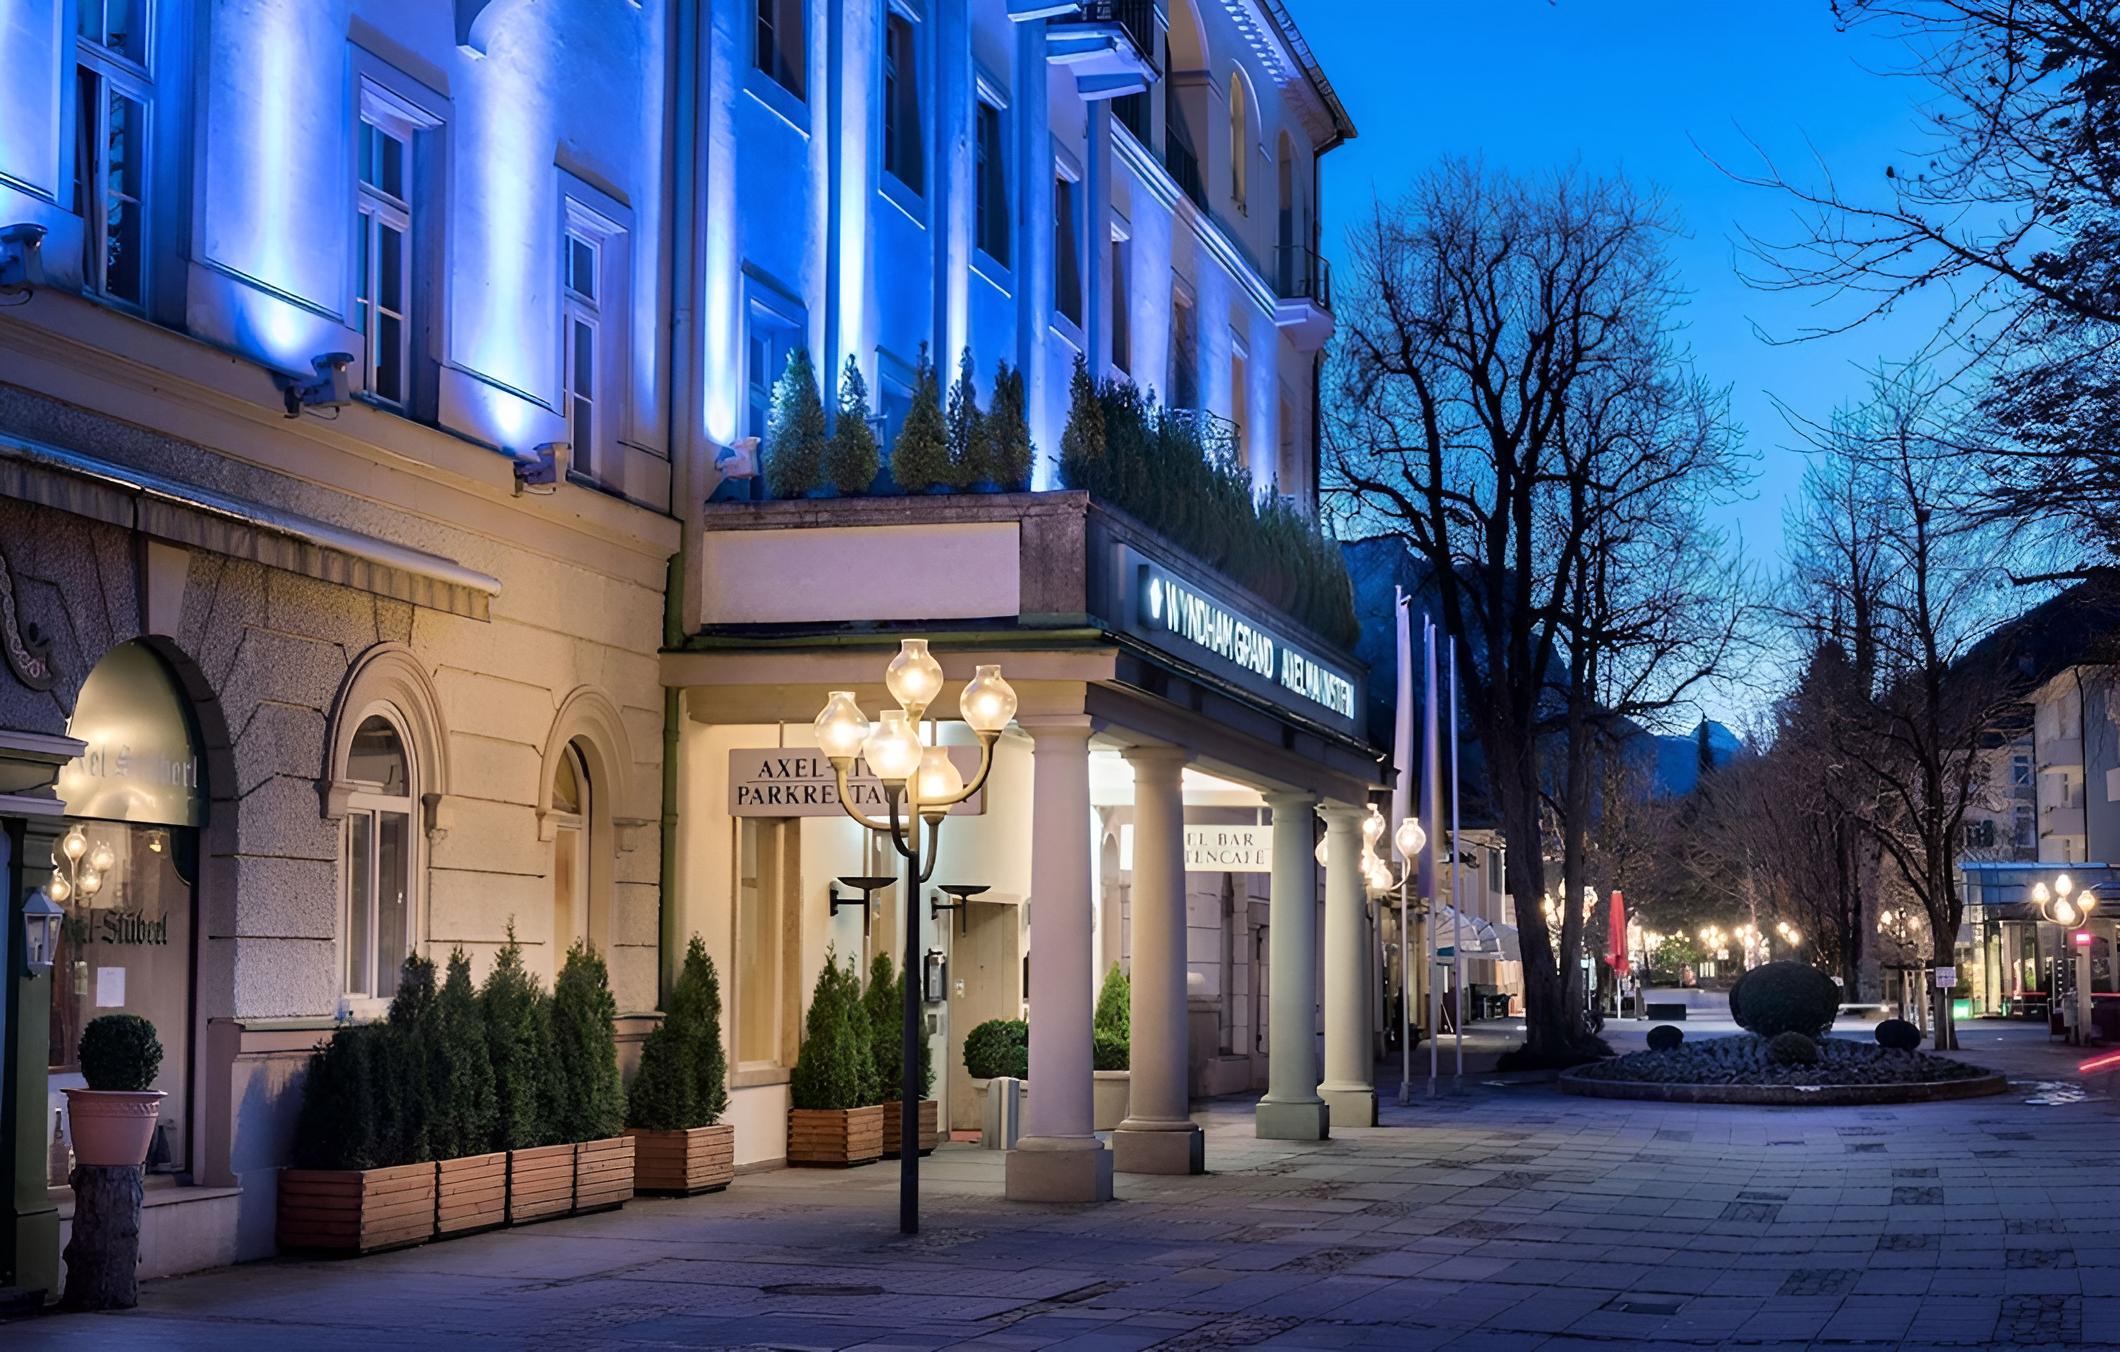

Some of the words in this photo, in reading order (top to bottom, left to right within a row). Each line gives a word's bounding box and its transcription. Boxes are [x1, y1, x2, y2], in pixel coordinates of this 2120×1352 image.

[1165, 580, 1233, 660] WYNDHAM
[1234, 621, 1274, 679] GRAND
[1218, 833, 1255, 846] BAR
